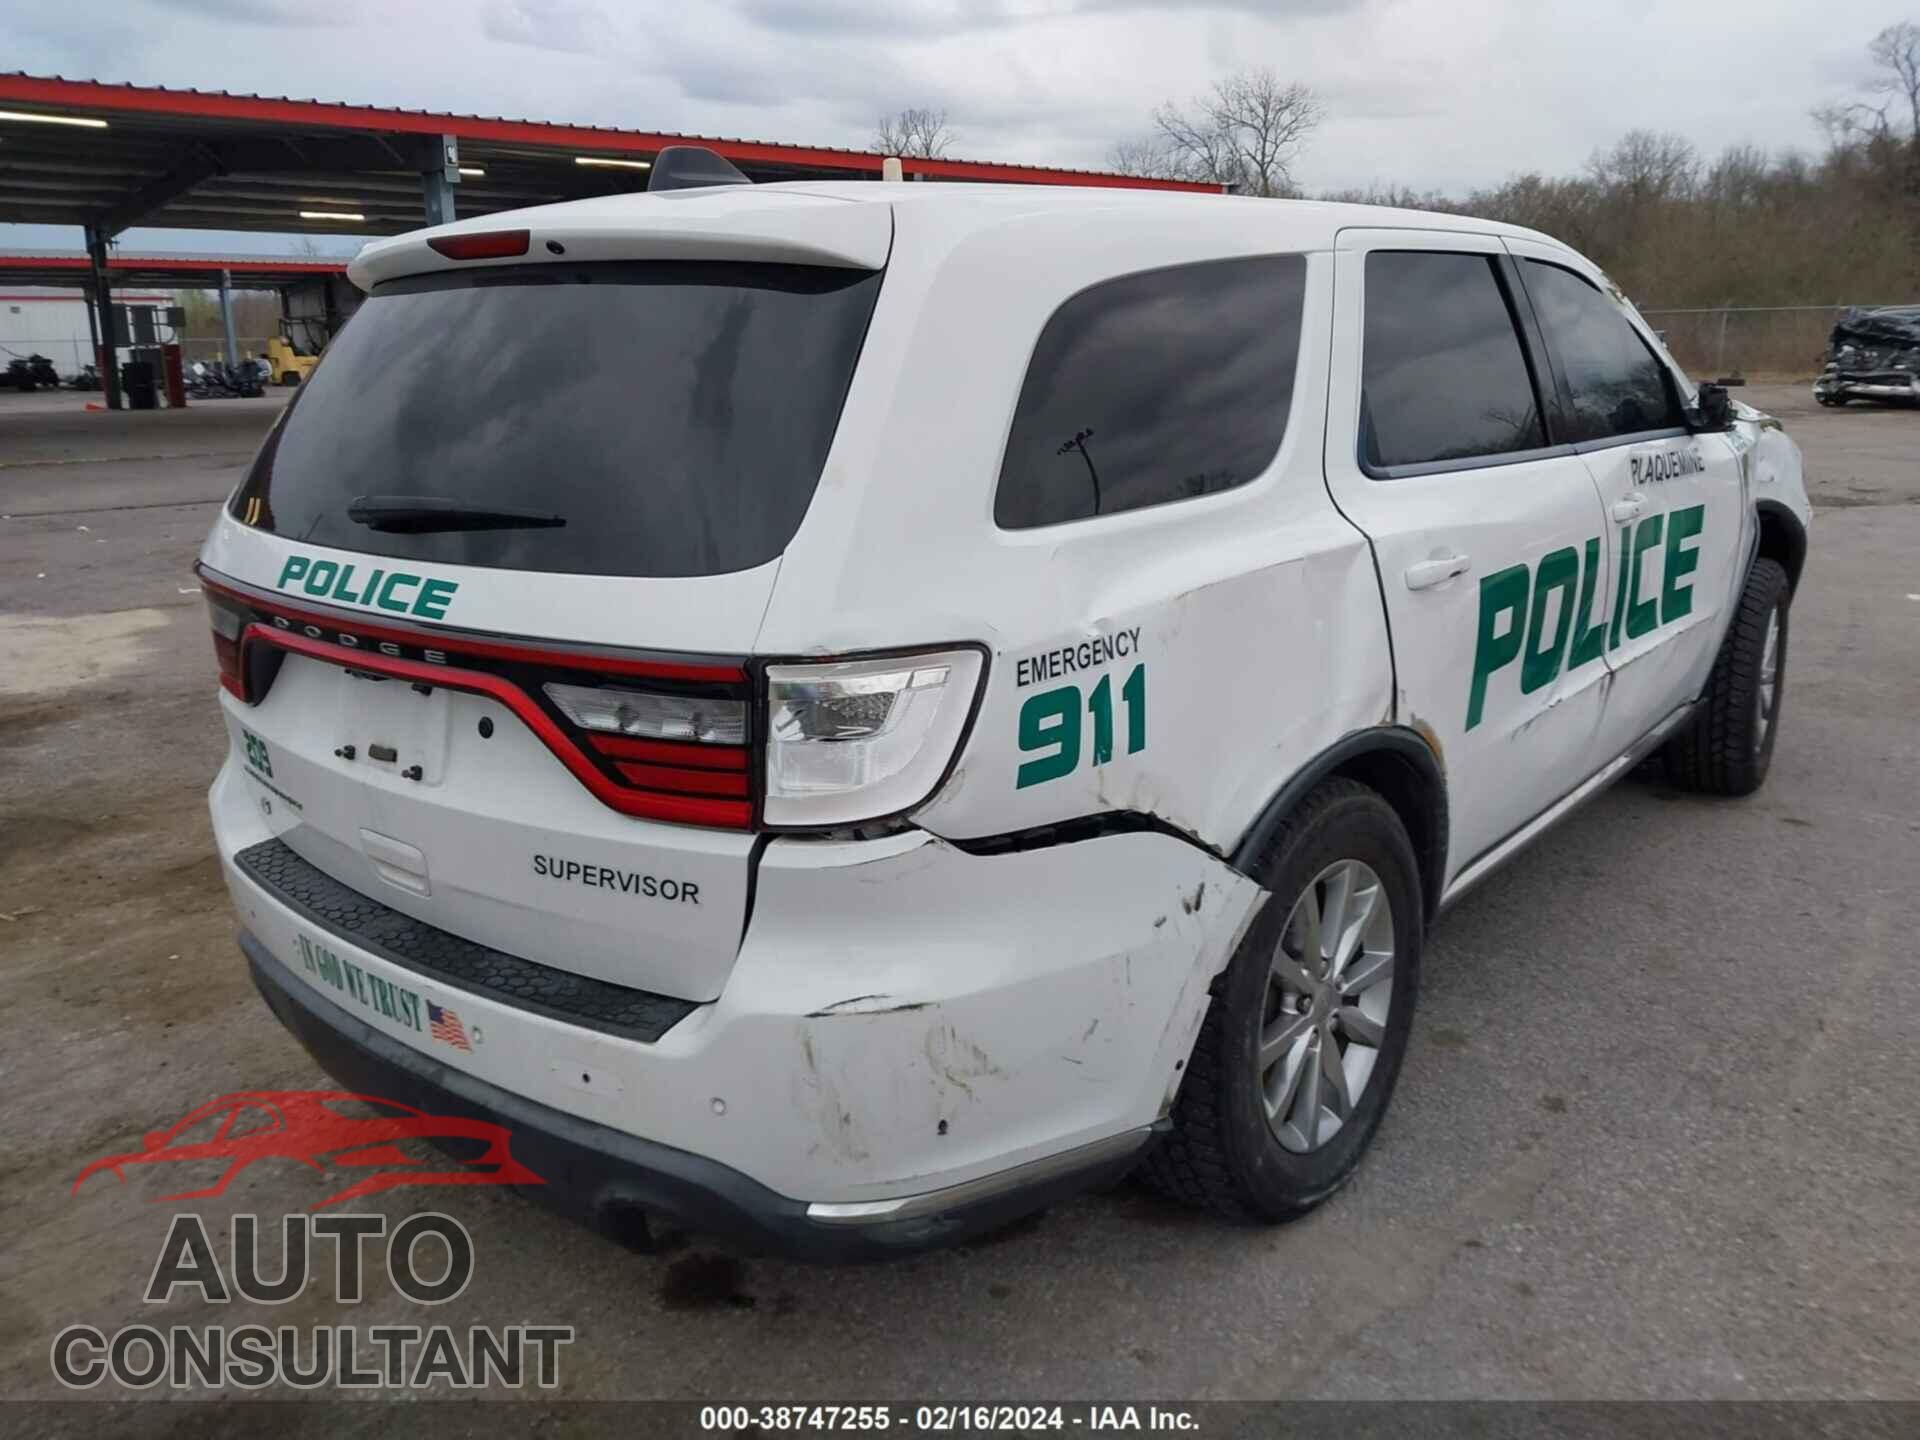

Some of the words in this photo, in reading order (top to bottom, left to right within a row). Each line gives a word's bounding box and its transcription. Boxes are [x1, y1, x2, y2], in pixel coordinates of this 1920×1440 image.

[276, 555, 459, 621] POLICE
[1465, 503, 1705, 733] POLICE
[272, 615, 448, 665] DODGE
[1016, 626, 1141, 688] EMERGENCY
[1015, 662, 1146, 790] 911
[533, 854, 700, 905] SUPERVISOR
[315, 943, 344, 991] GOD
[342, 959, 369, 1007] WE
[366, 972, 423, 1033] TRUST
